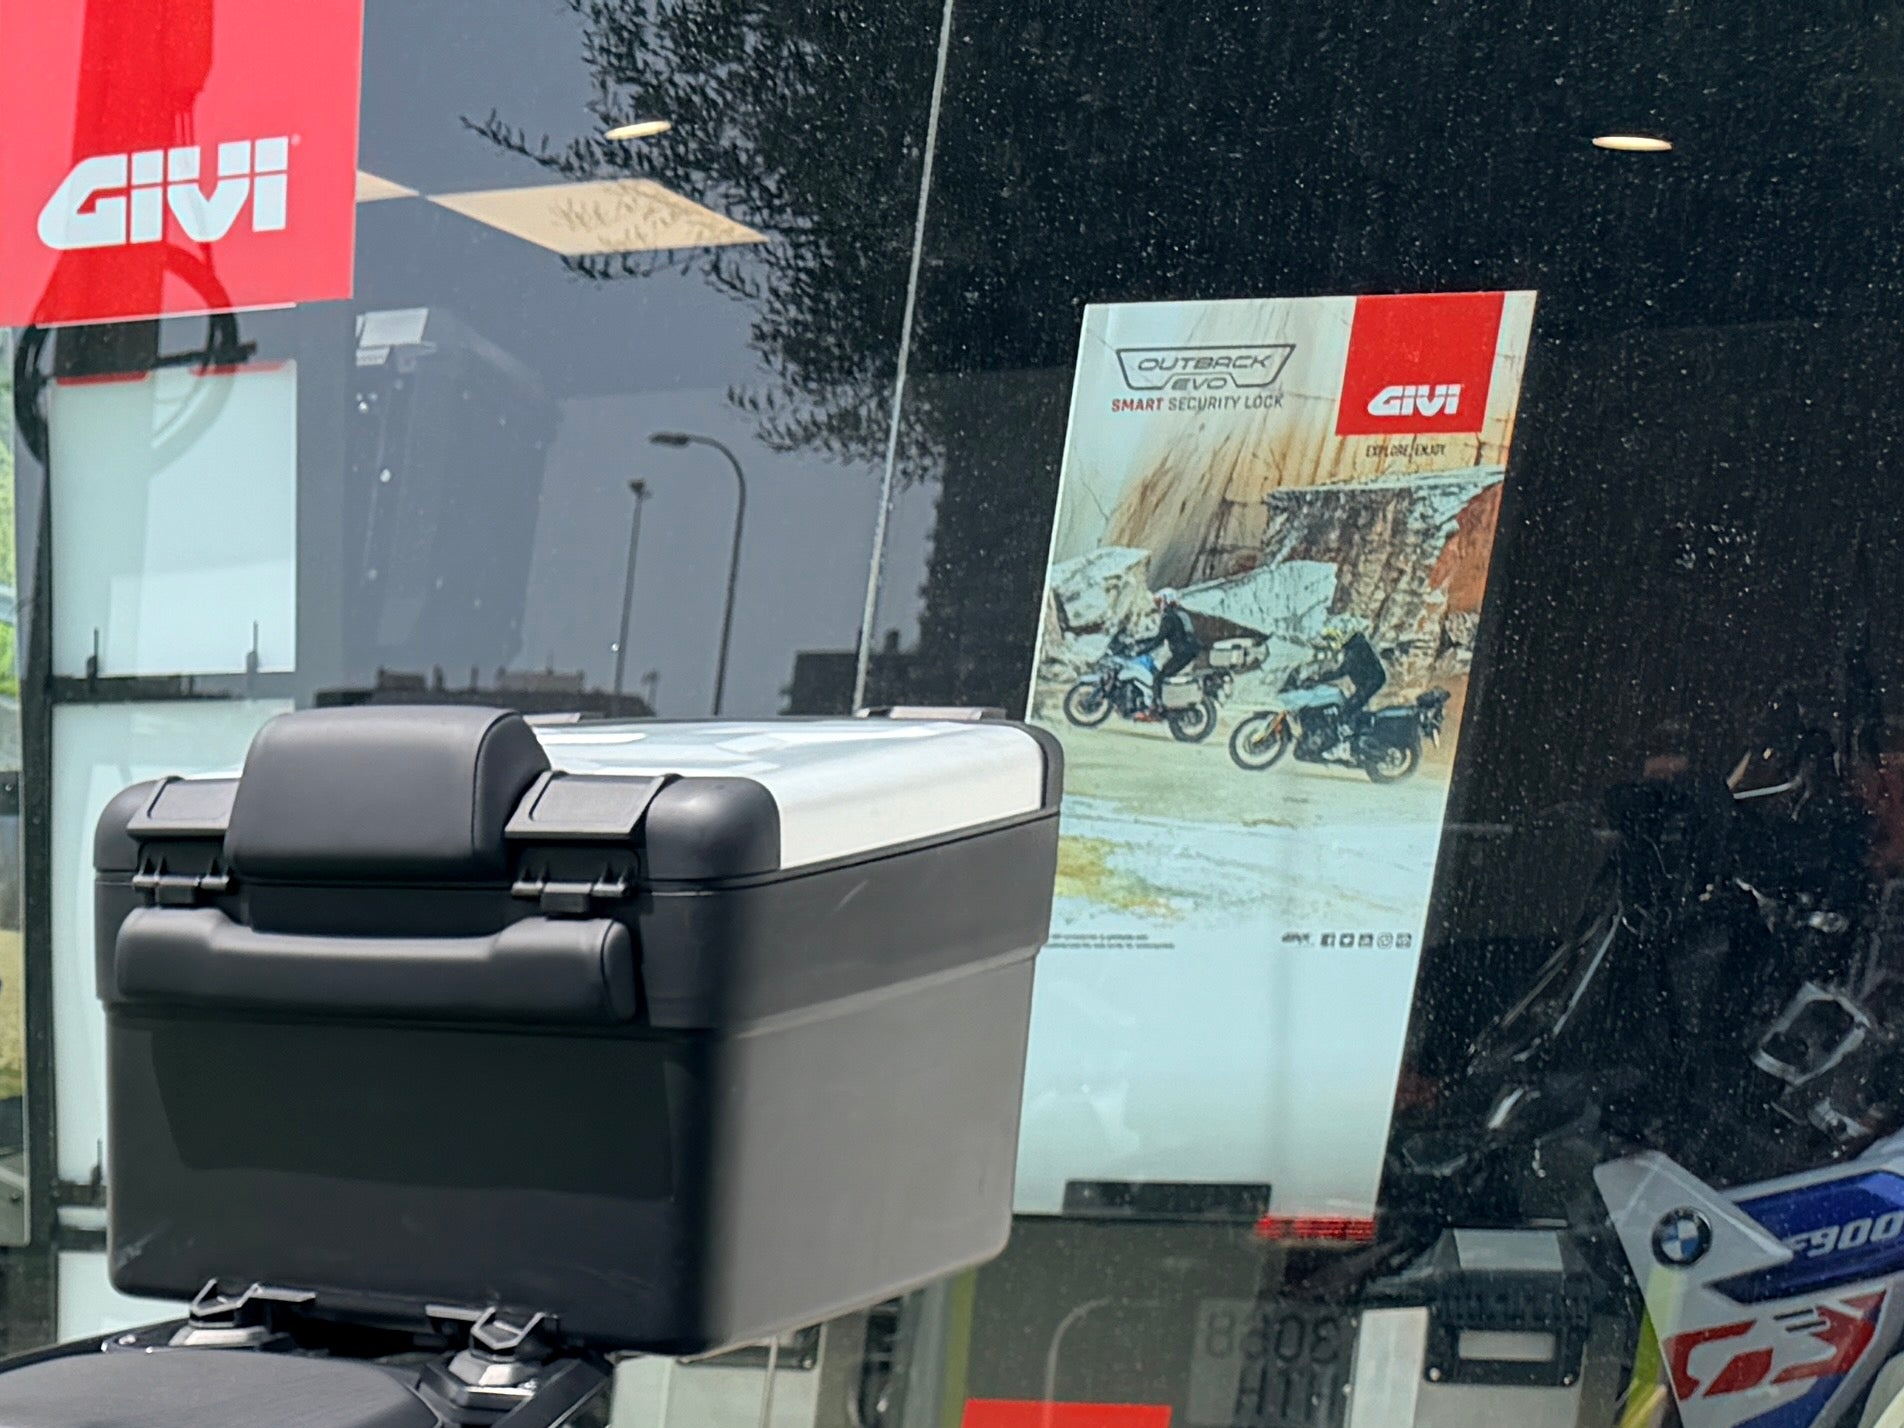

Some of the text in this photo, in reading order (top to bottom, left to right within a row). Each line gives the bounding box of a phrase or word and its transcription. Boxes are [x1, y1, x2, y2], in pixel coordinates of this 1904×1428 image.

[37, 136, 290, 250] GIVI
[1138, 355, 1273, 371] OUTBACK
[1171, 377, 1228, 391] EVO
[1111, 393, 1285, 413] SMART SECURITY LOCK
[1367, 384, 1462, 417] GIVI
